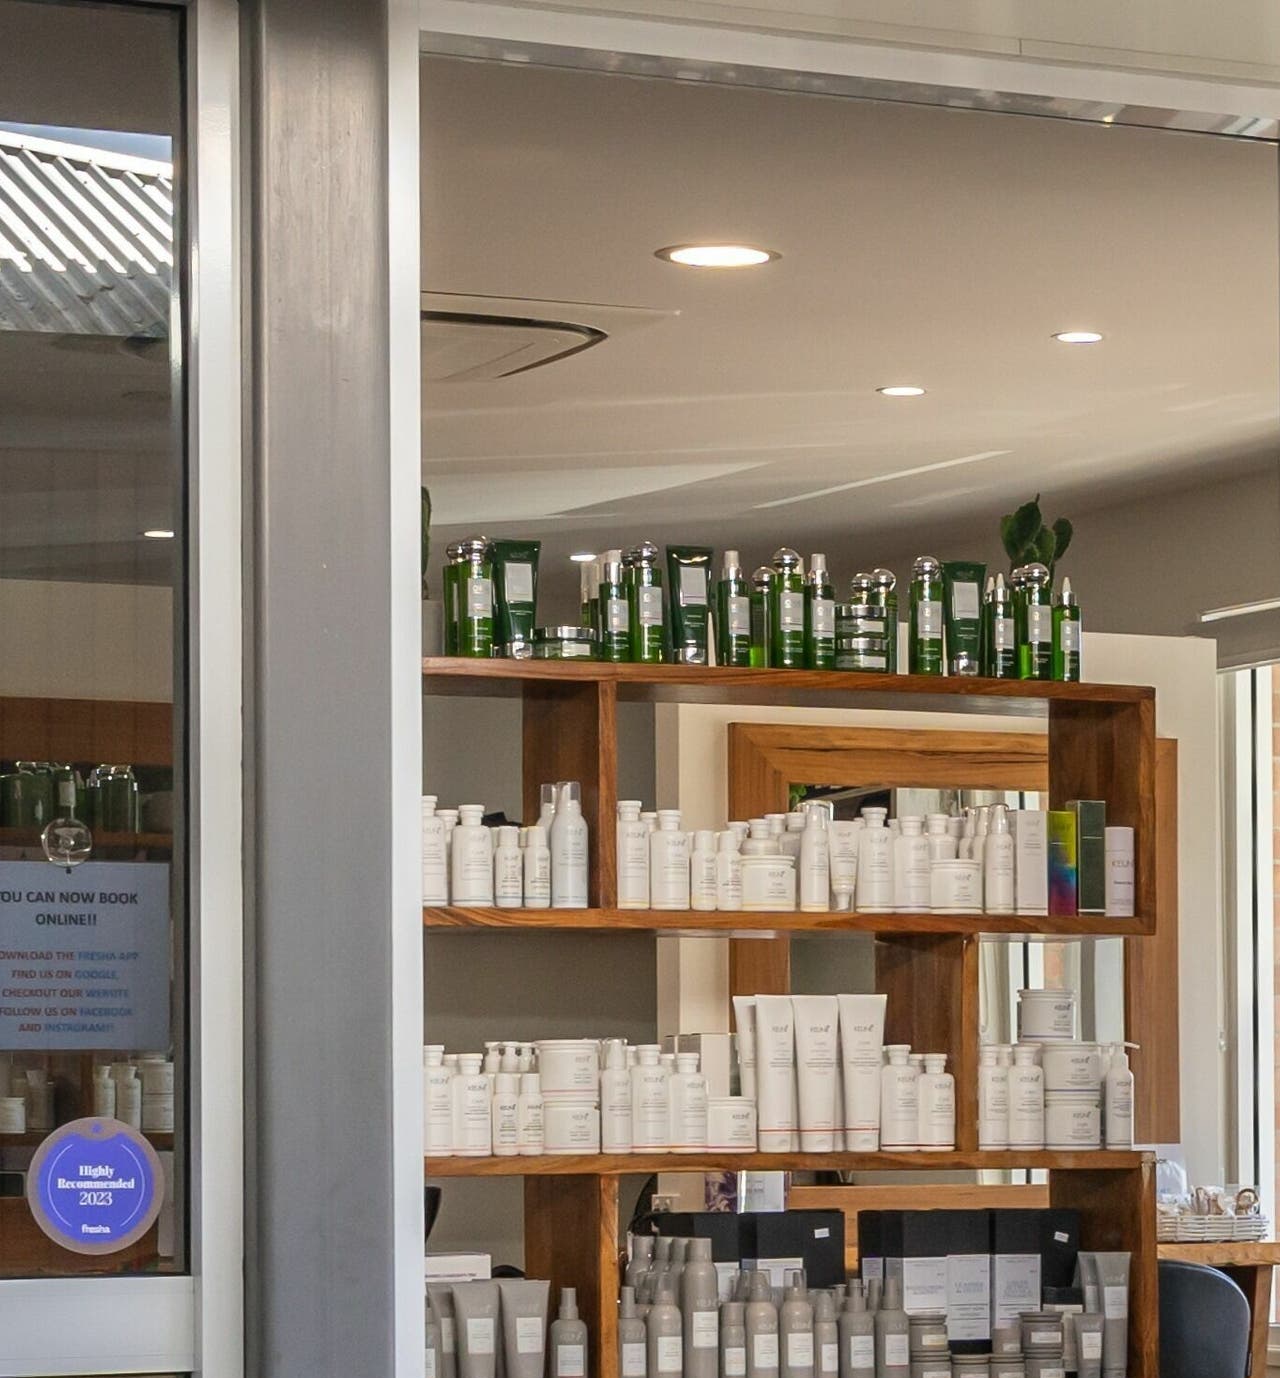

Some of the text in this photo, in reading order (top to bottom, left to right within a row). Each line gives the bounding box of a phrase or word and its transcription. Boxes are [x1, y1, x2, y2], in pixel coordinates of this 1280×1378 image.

[26, 891, 56, 904] CAN
[59, 891, 96, 904] NOW
[99, 892, 138, 905] BOOK
[35, 913, 97, 926] ONLINE!!
[56, 951, 75, 960] THE
[60, 988, 83, 998] OUR
[18, 1023, 42, 1033] AND
[79, 1166, 115, 1178] Highly
[57, 1178, 135, 1189] Recommended
[79, 1191, 113, 1206] 2023
